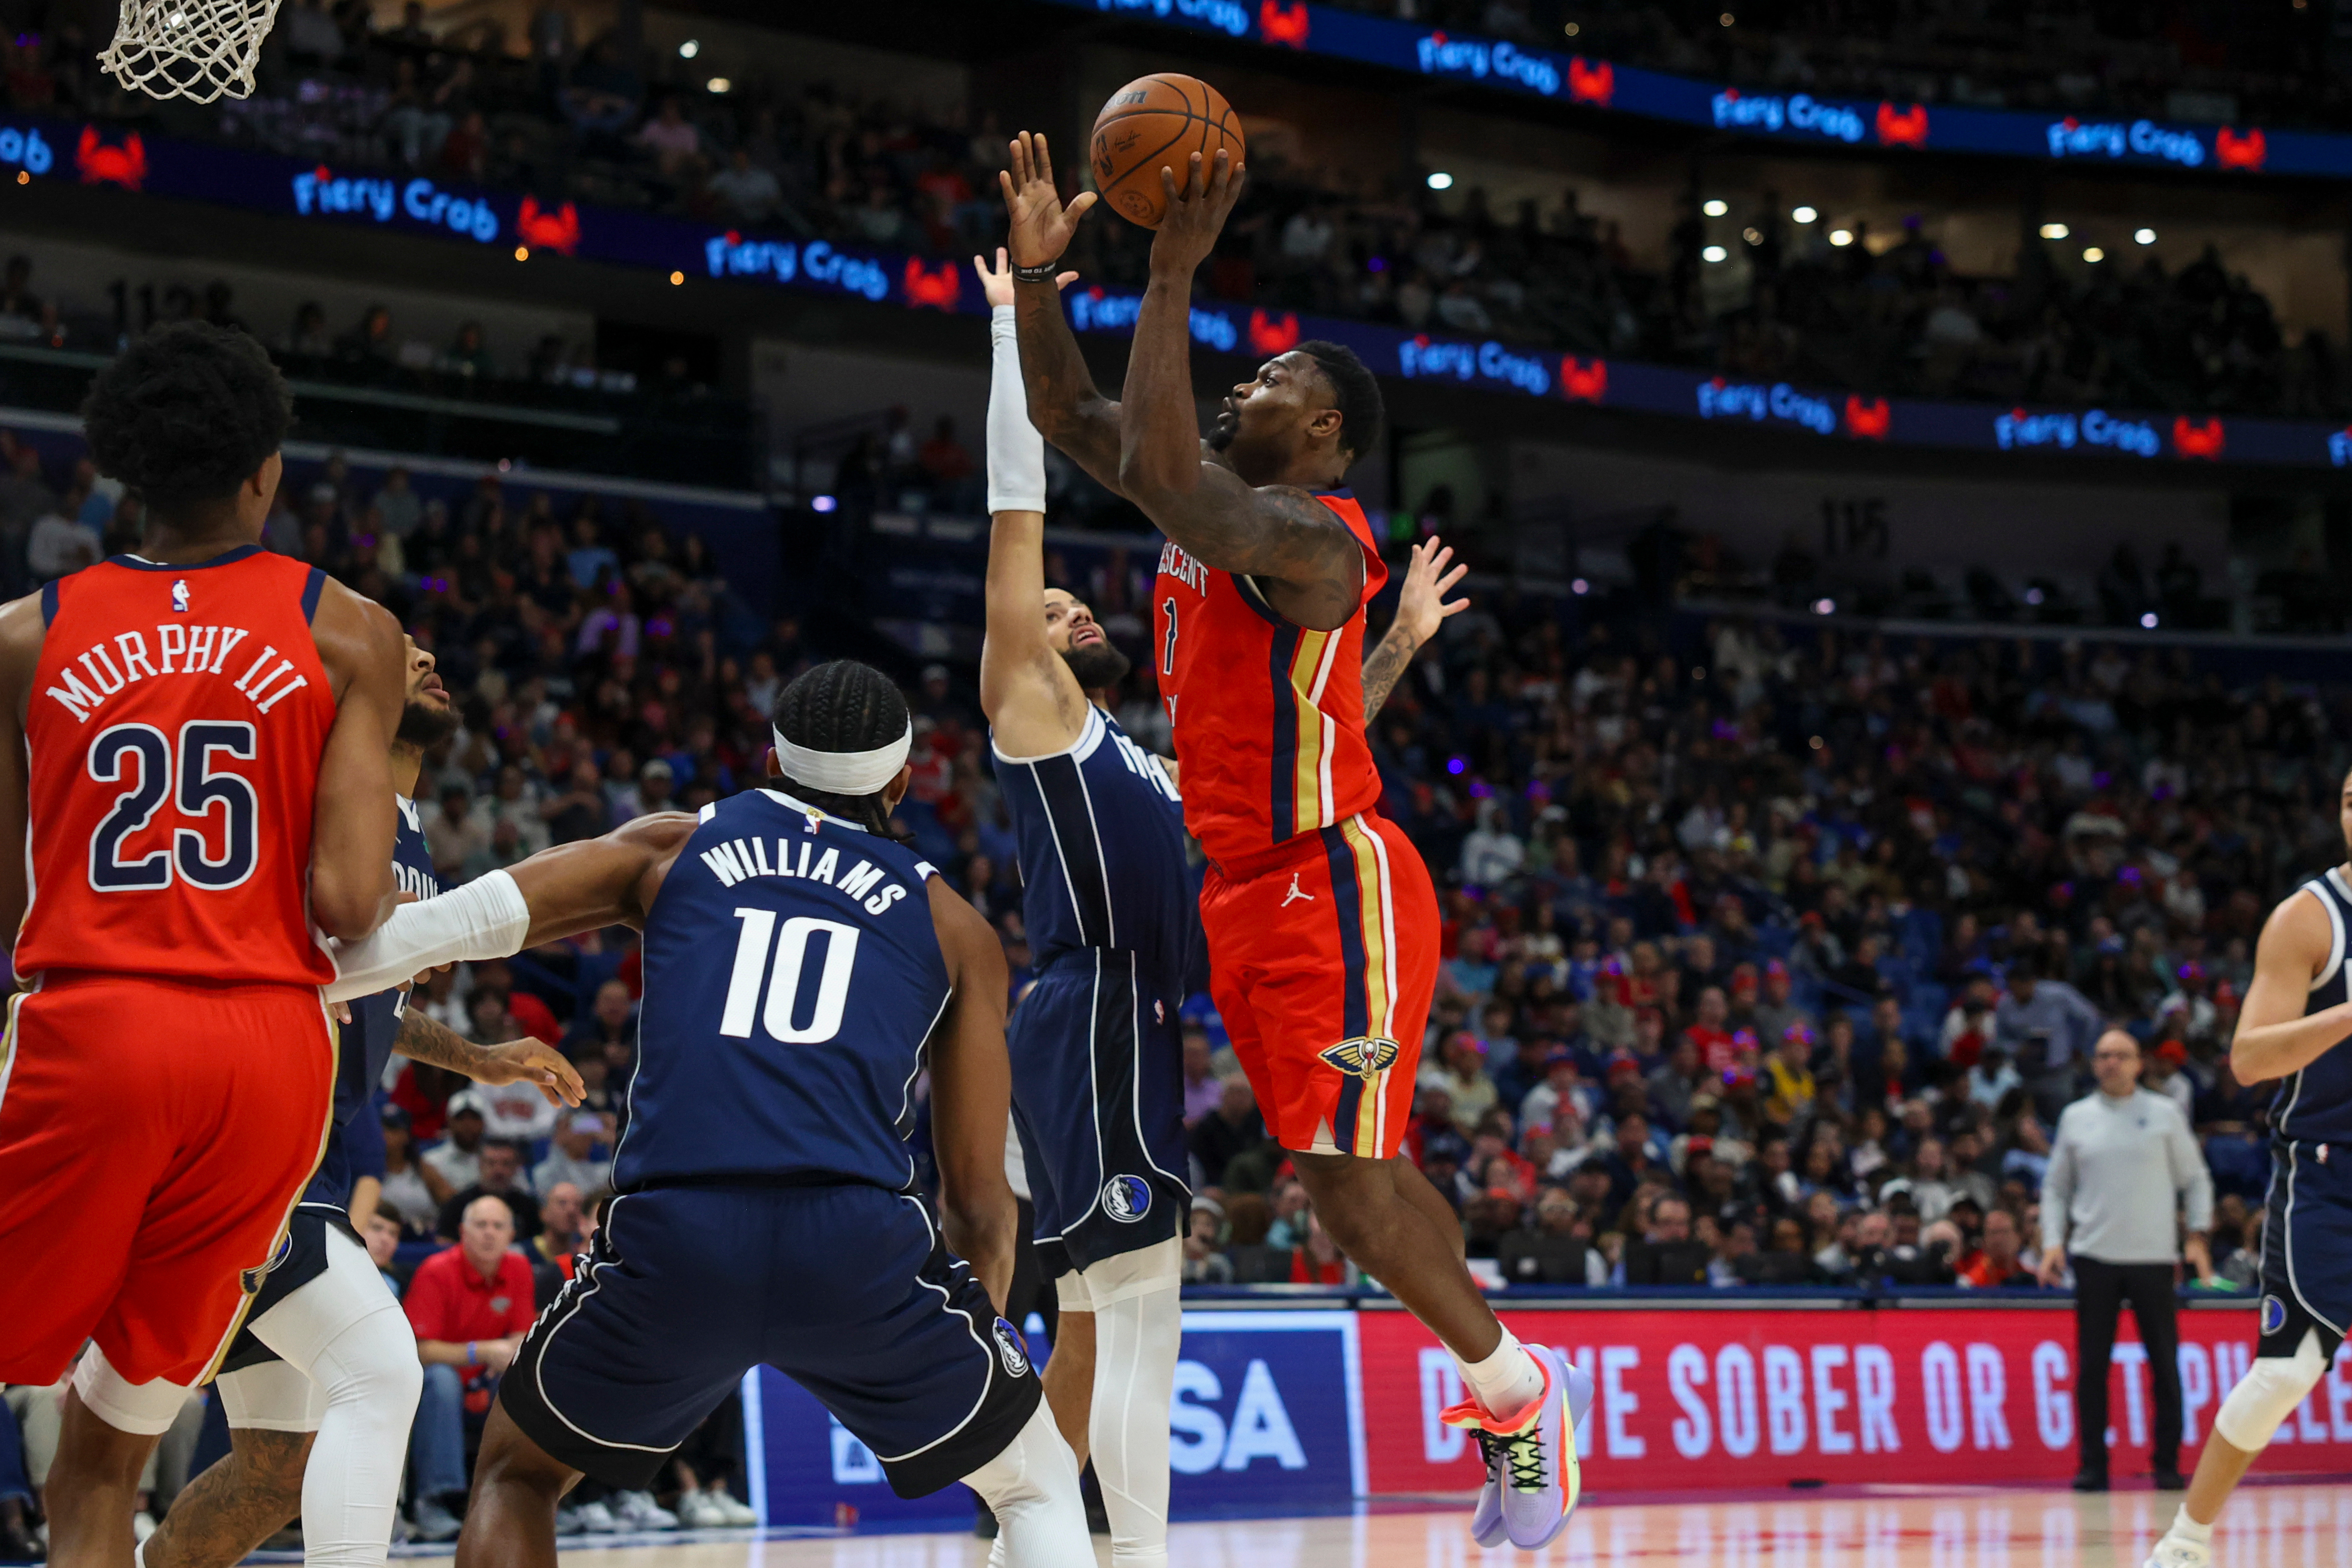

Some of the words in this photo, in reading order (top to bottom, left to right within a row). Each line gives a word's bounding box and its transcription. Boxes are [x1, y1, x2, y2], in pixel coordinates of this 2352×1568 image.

[293, 164, 395, 222] Fiery
[403, 179, 499, 243] Crab
[704, 230, 797, 283] Fiery
[803, 240, 889, 301] Crab
[45, 623, 250, 724] MURPHY
[233, 645, 309, 715] III
[1162, 596, 1178, 676] 1
[87, 719, 259, 893] 25
[699, 836, 908, 916] WILLIAMS
[719, 907, 860, 1044] 10
[1667, 1342, 1901, 1460] SOBER
[1921, 1340, 2013, 1453] OR
[2031, 1340, 2150, 1451] GT
